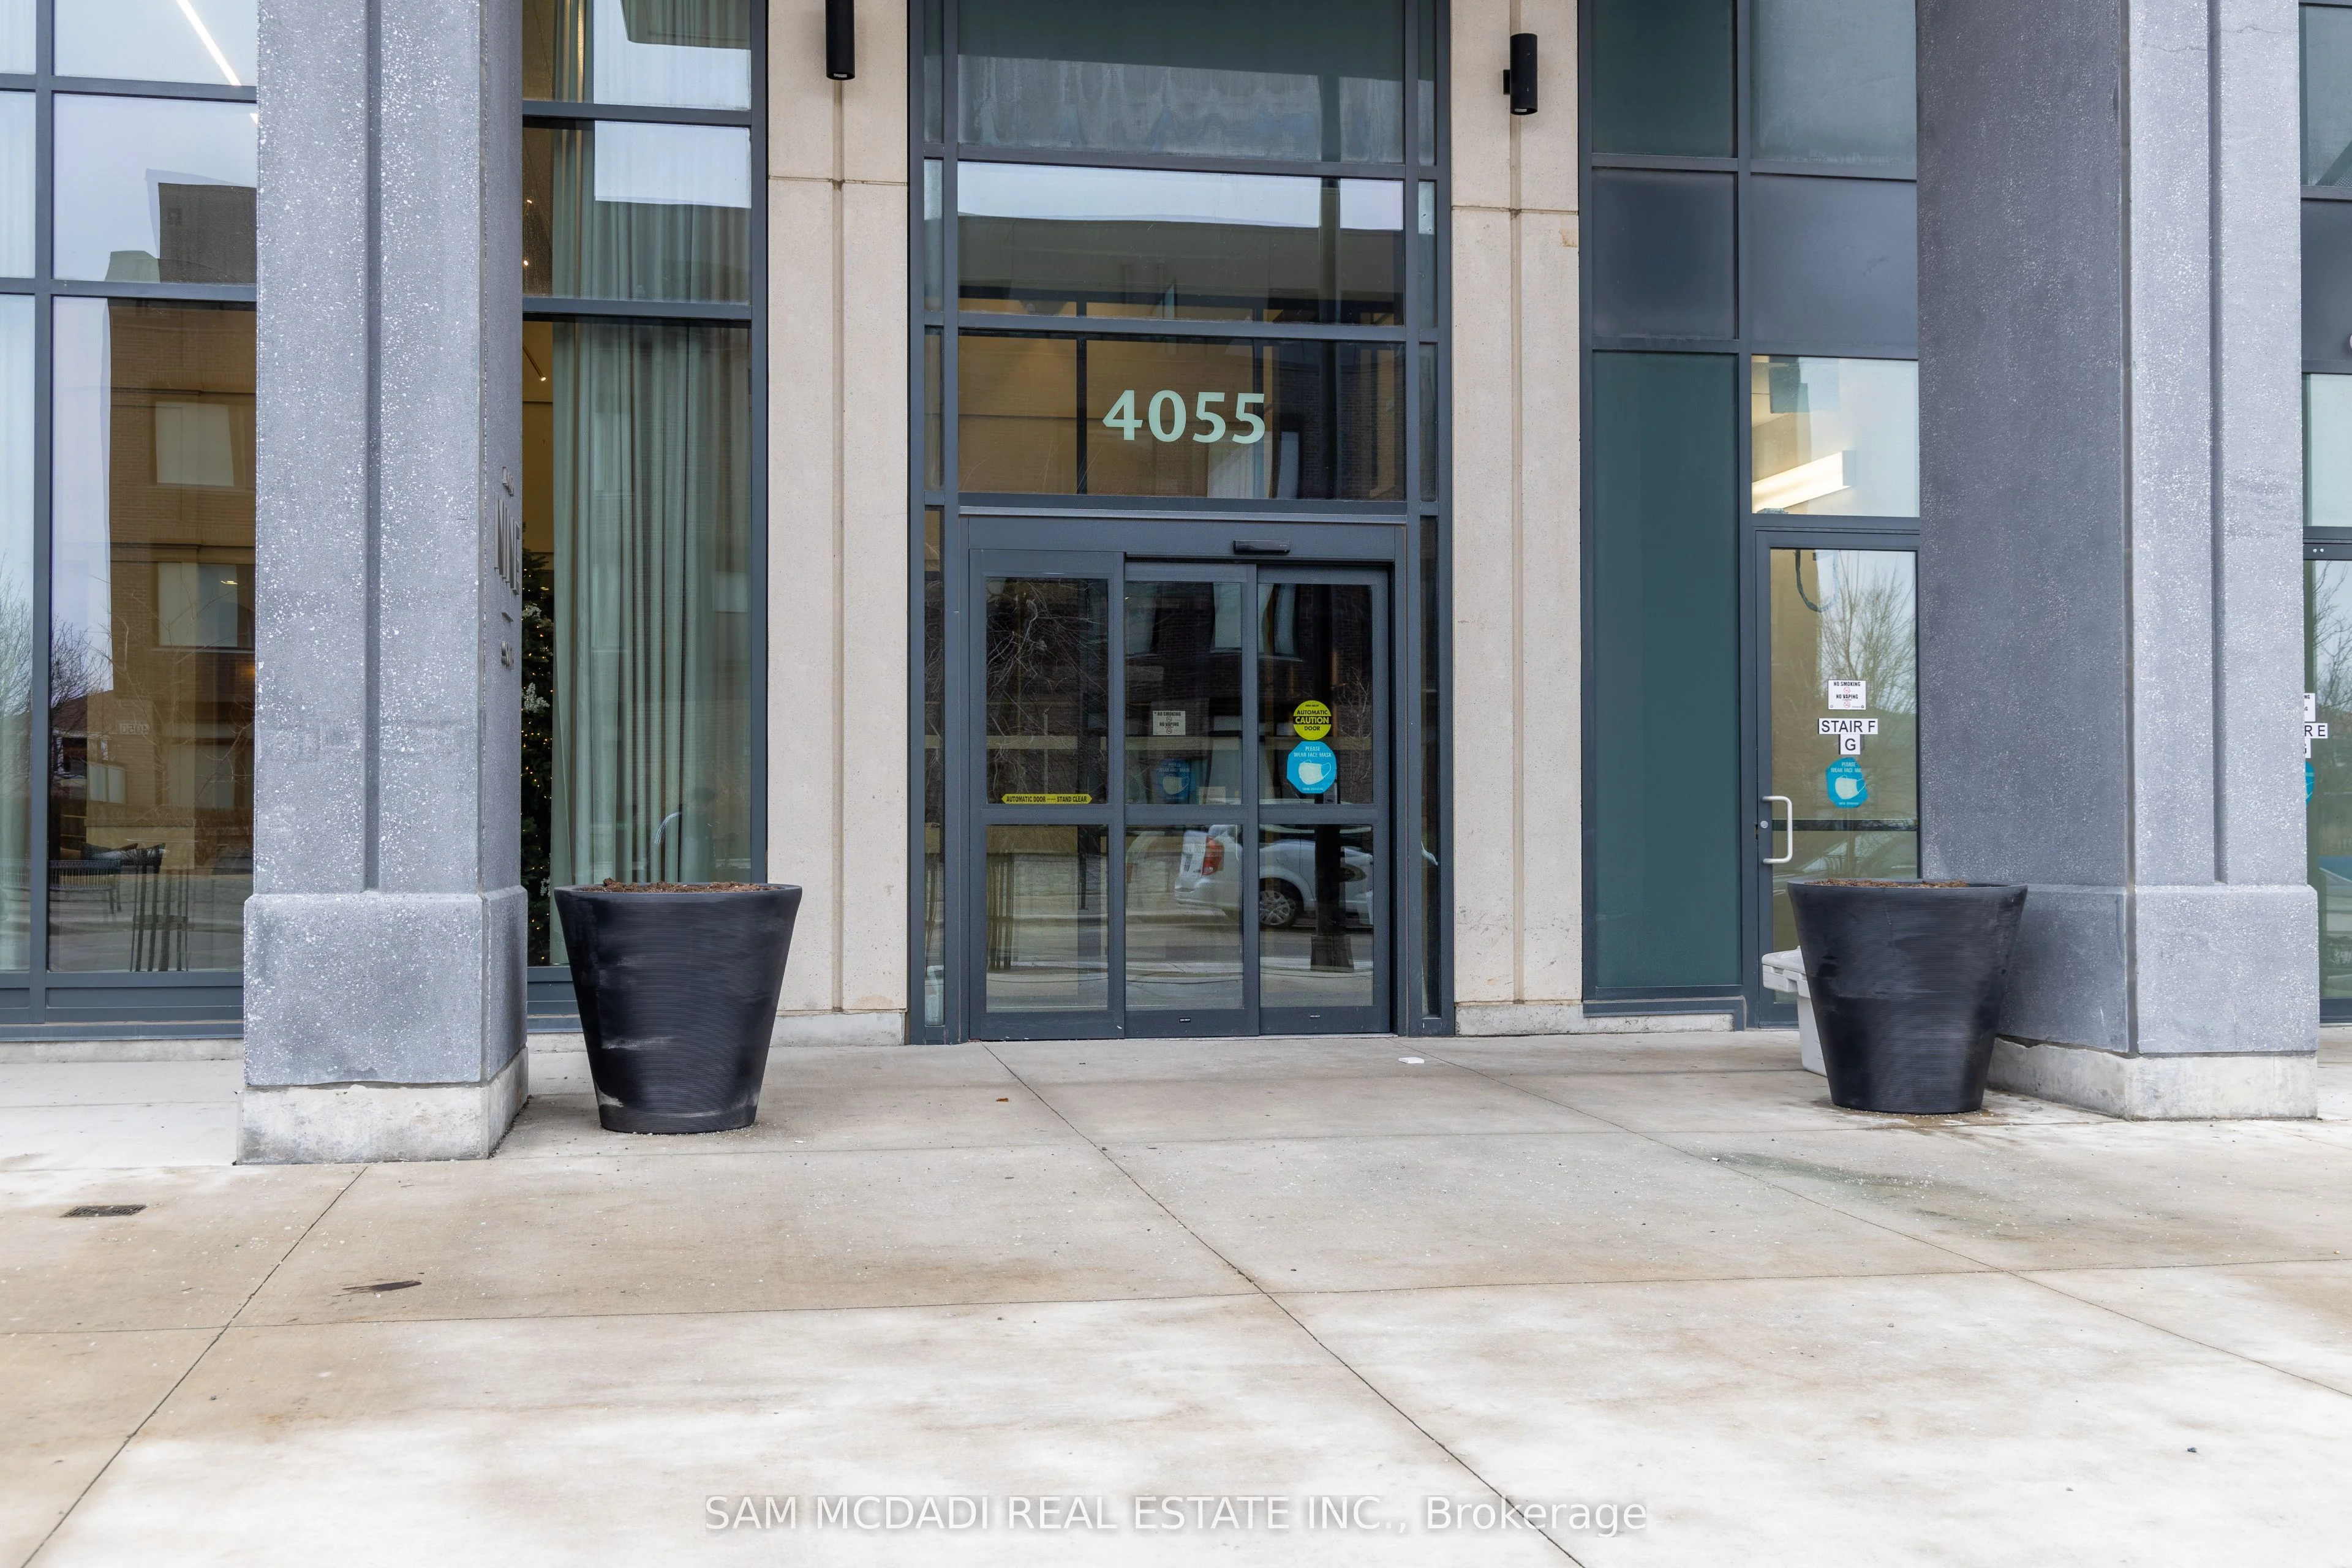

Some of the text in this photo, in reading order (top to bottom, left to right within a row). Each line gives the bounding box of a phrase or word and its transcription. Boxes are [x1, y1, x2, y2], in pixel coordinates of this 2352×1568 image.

[1102, 390, 1265, 444] 4055
[1822, 720, 1875, 733] STAIR F
[2318, 725, 2326, 737] E
[1845, 738, 1856, 751] G
